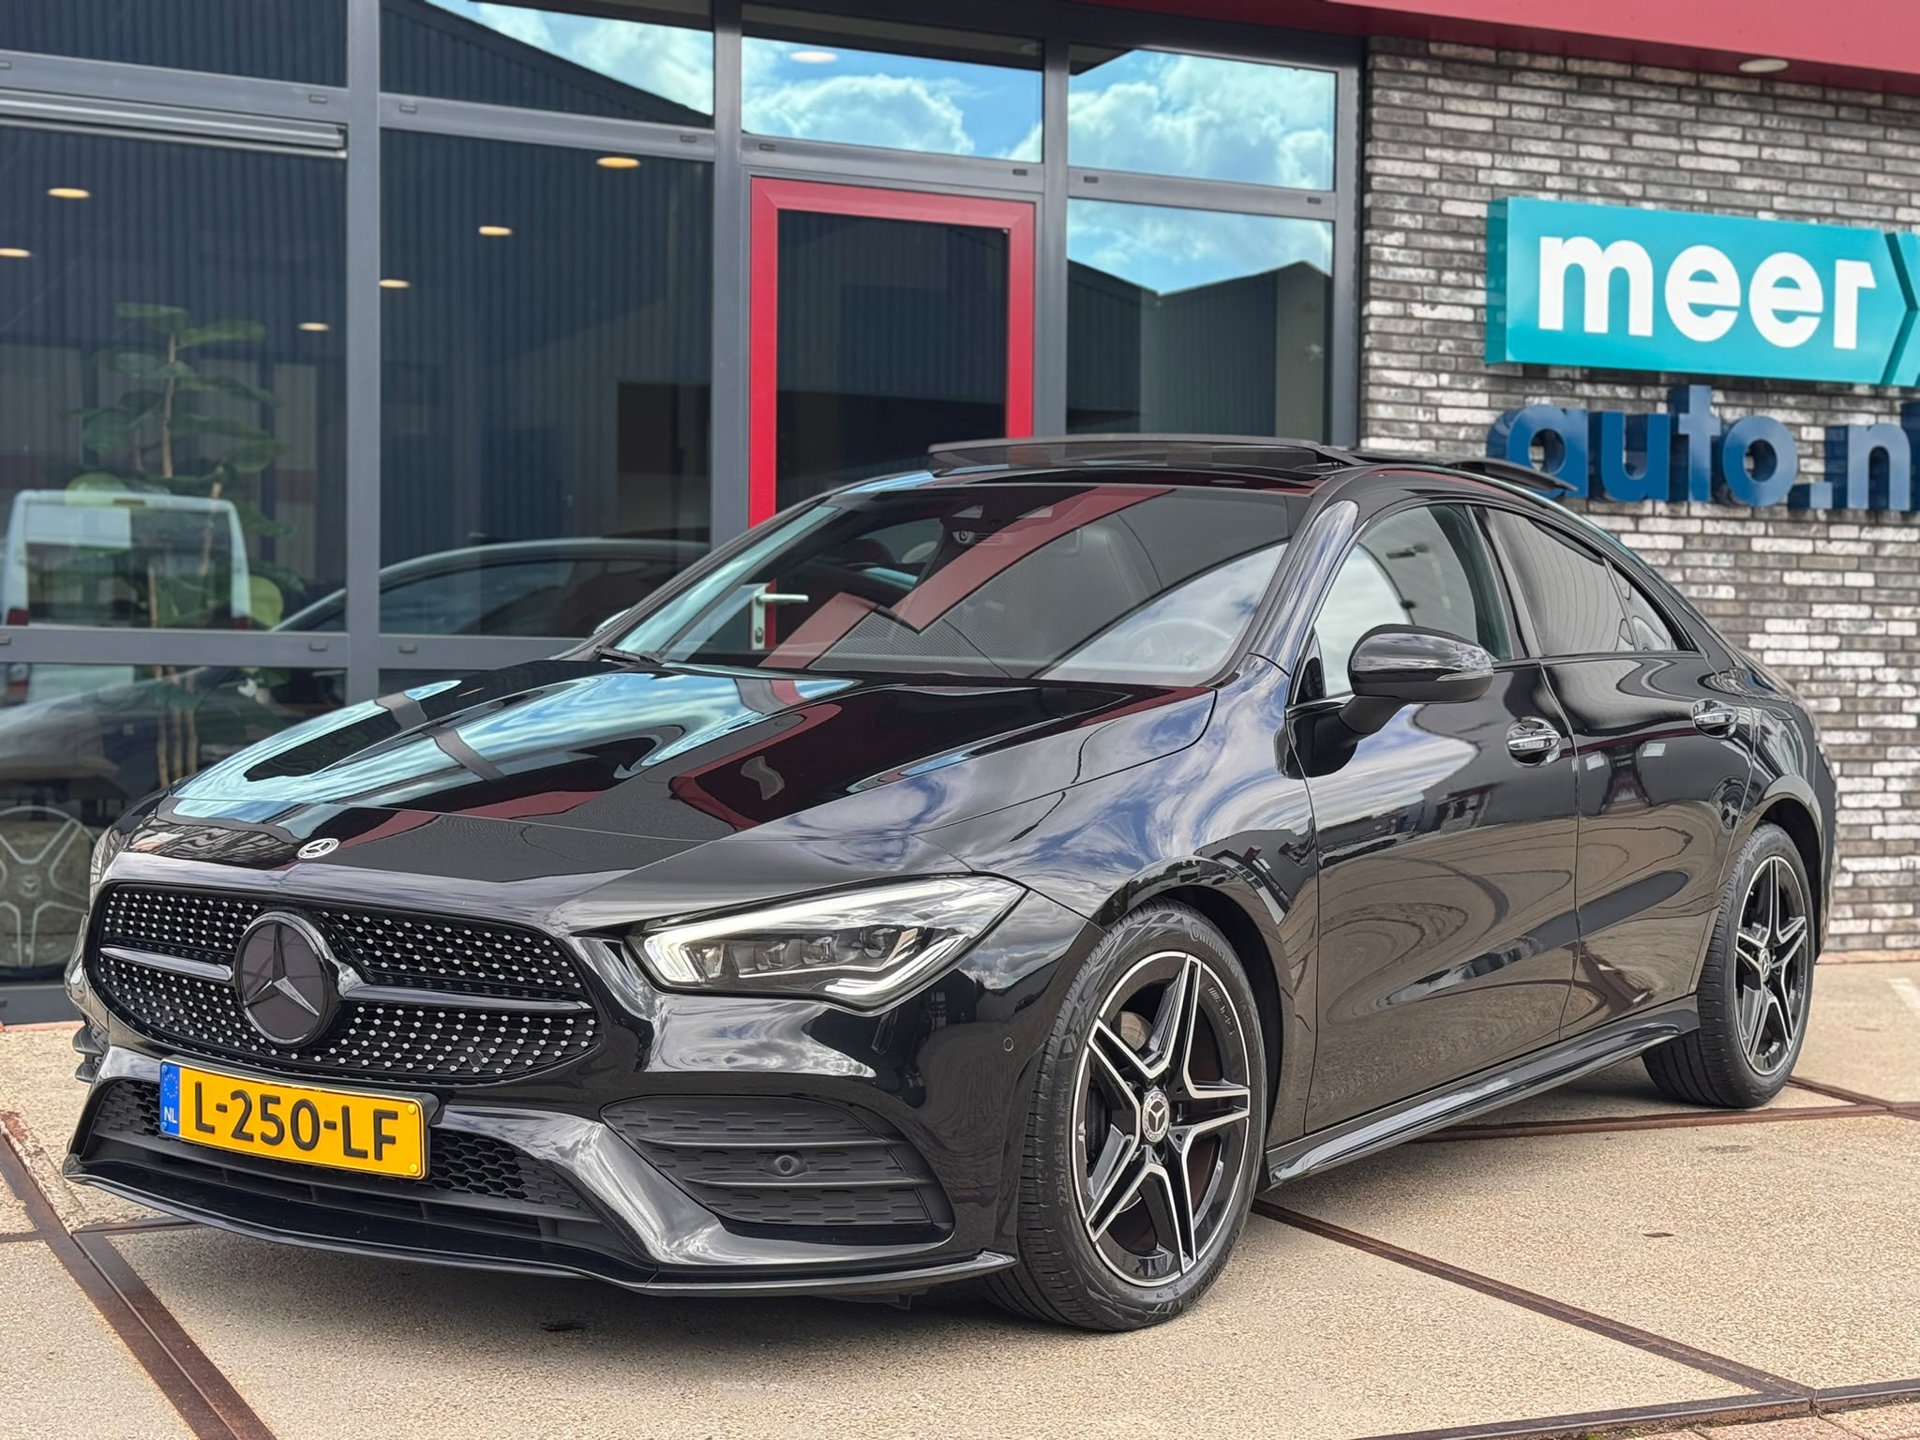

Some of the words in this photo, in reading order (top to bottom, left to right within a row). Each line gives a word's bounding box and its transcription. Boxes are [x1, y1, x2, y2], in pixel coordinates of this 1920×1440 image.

[1538, 236, 1877, 350] meer
[1486, 384, 1920, 512] auto.n
[163, 1105, 178, 1125] NL
[194, 1081, 399, 1161] L-250-LF
